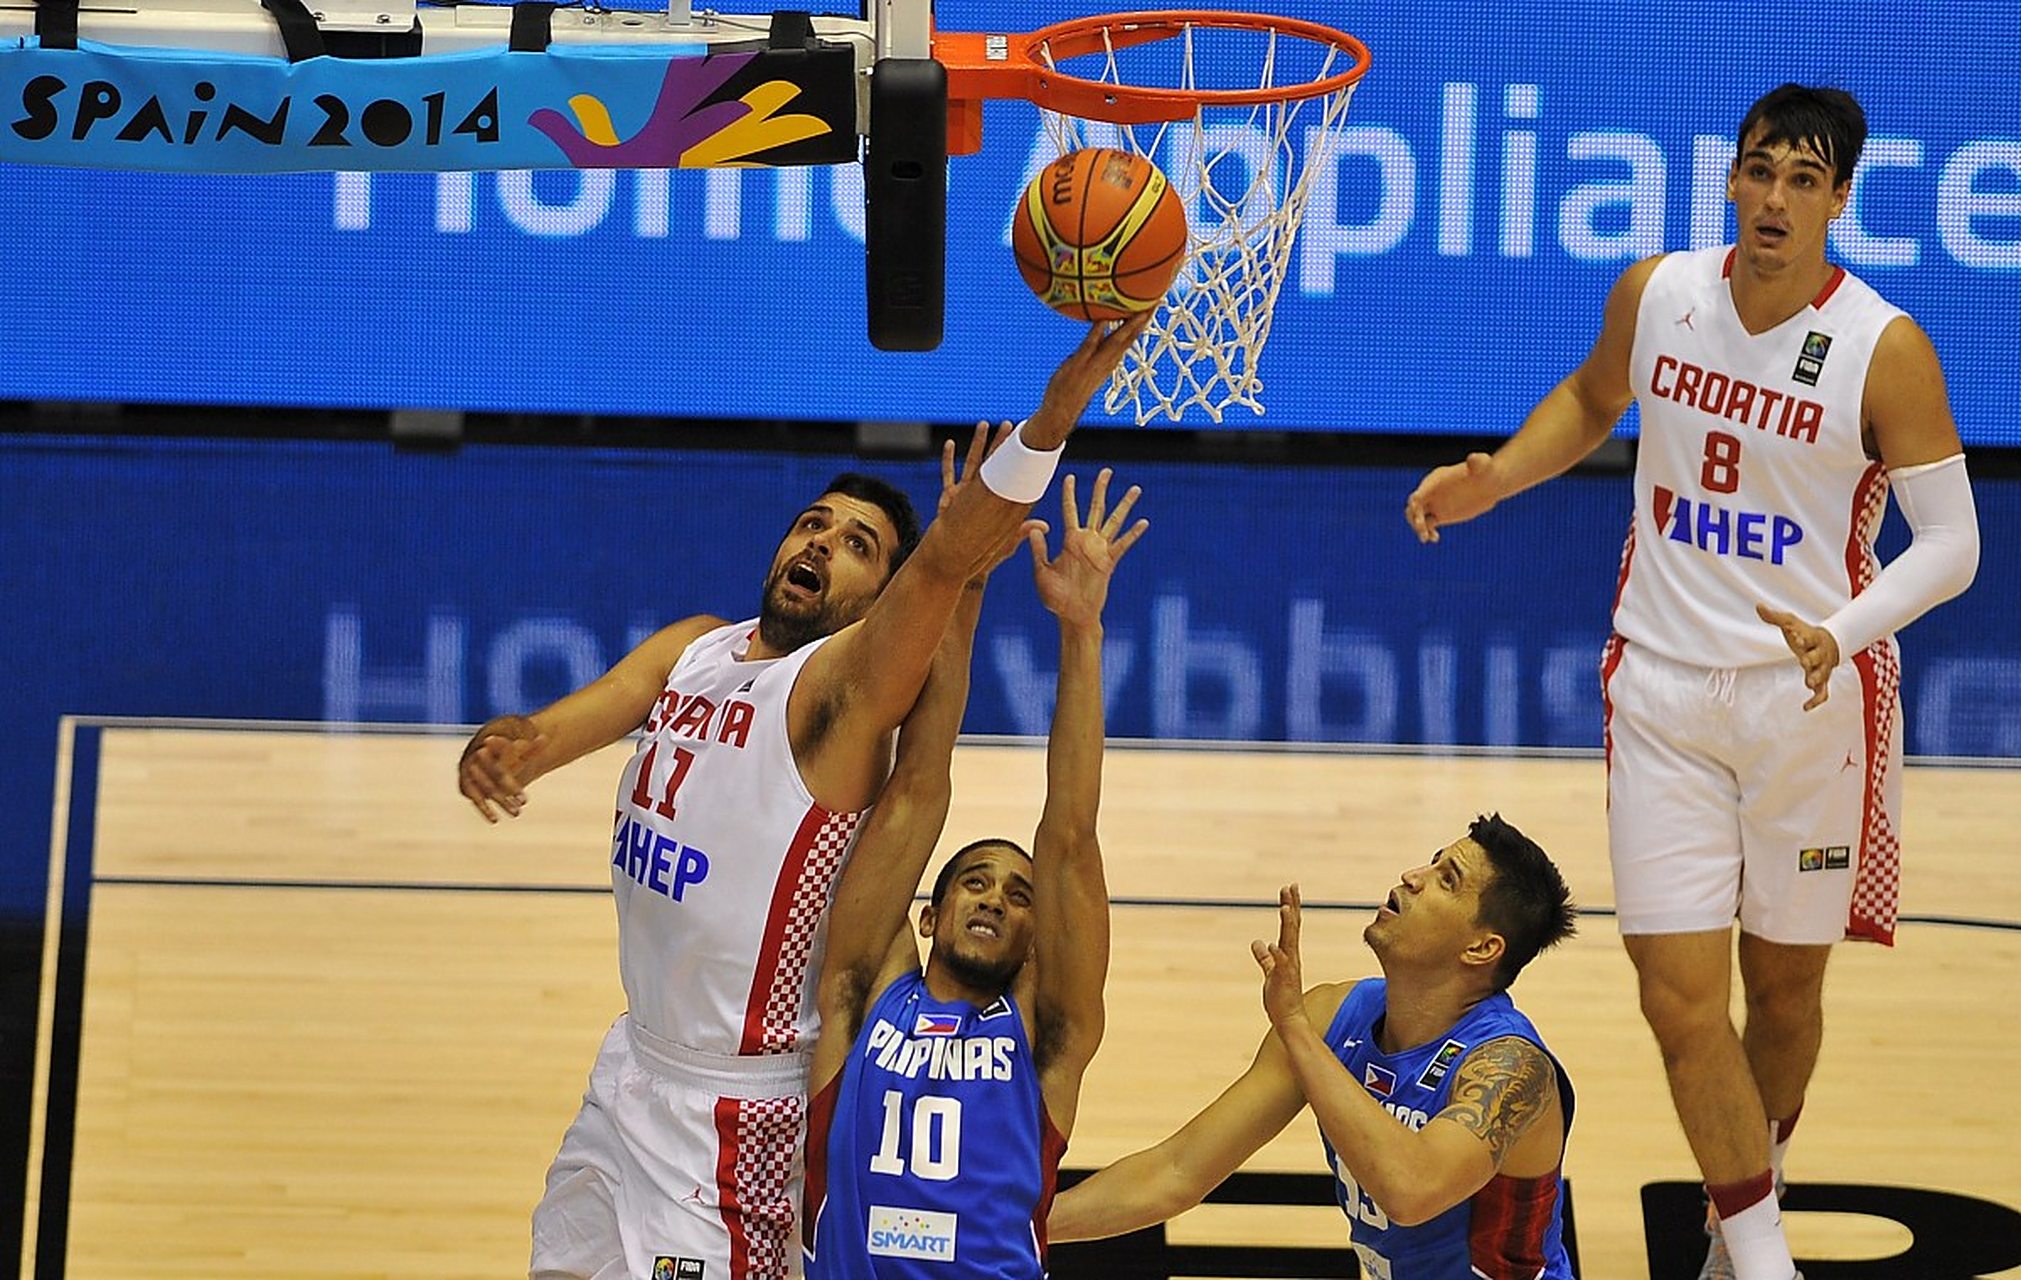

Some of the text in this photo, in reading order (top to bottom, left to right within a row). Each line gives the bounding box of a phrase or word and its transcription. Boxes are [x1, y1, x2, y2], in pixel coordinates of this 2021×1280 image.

[306, 85, 499, 147] 2014
[1650, 355, 1824, 444] CROATIA
[1700, 430, 1741, 494] 8
[1696, 502, 1804, 565] HEP
[630, 740, 696, 822] 11
[627, 819, 711, 903] HEP
[869, 1090, 962, 1181] 10
[871, 1230, 951, 1254] SMART
